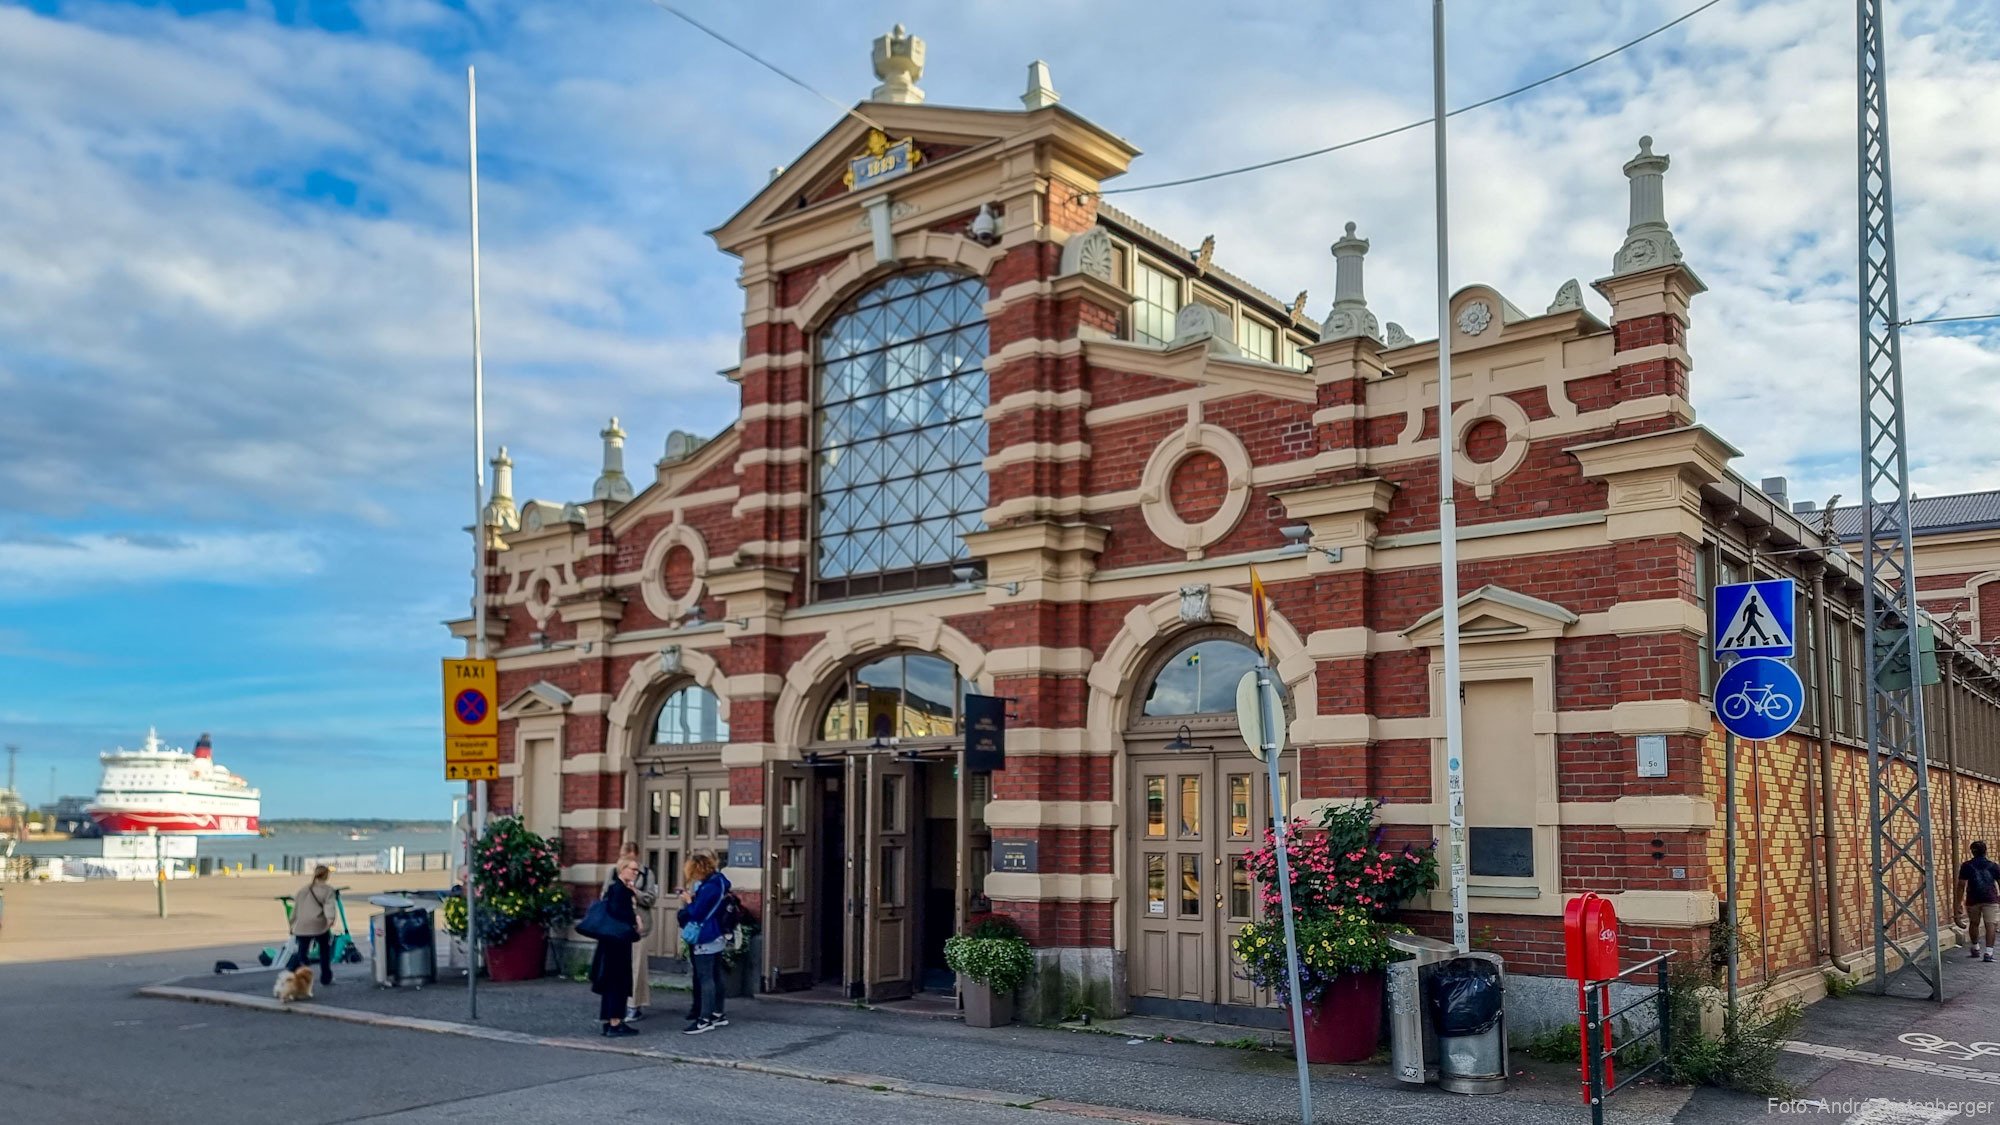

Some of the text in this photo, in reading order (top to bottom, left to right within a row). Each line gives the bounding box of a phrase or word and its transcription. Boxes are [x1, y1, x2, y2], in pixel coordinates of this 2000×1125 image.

[455, 665, 485, 678] TAXI
[463, 765, 482, 777] 5 m
